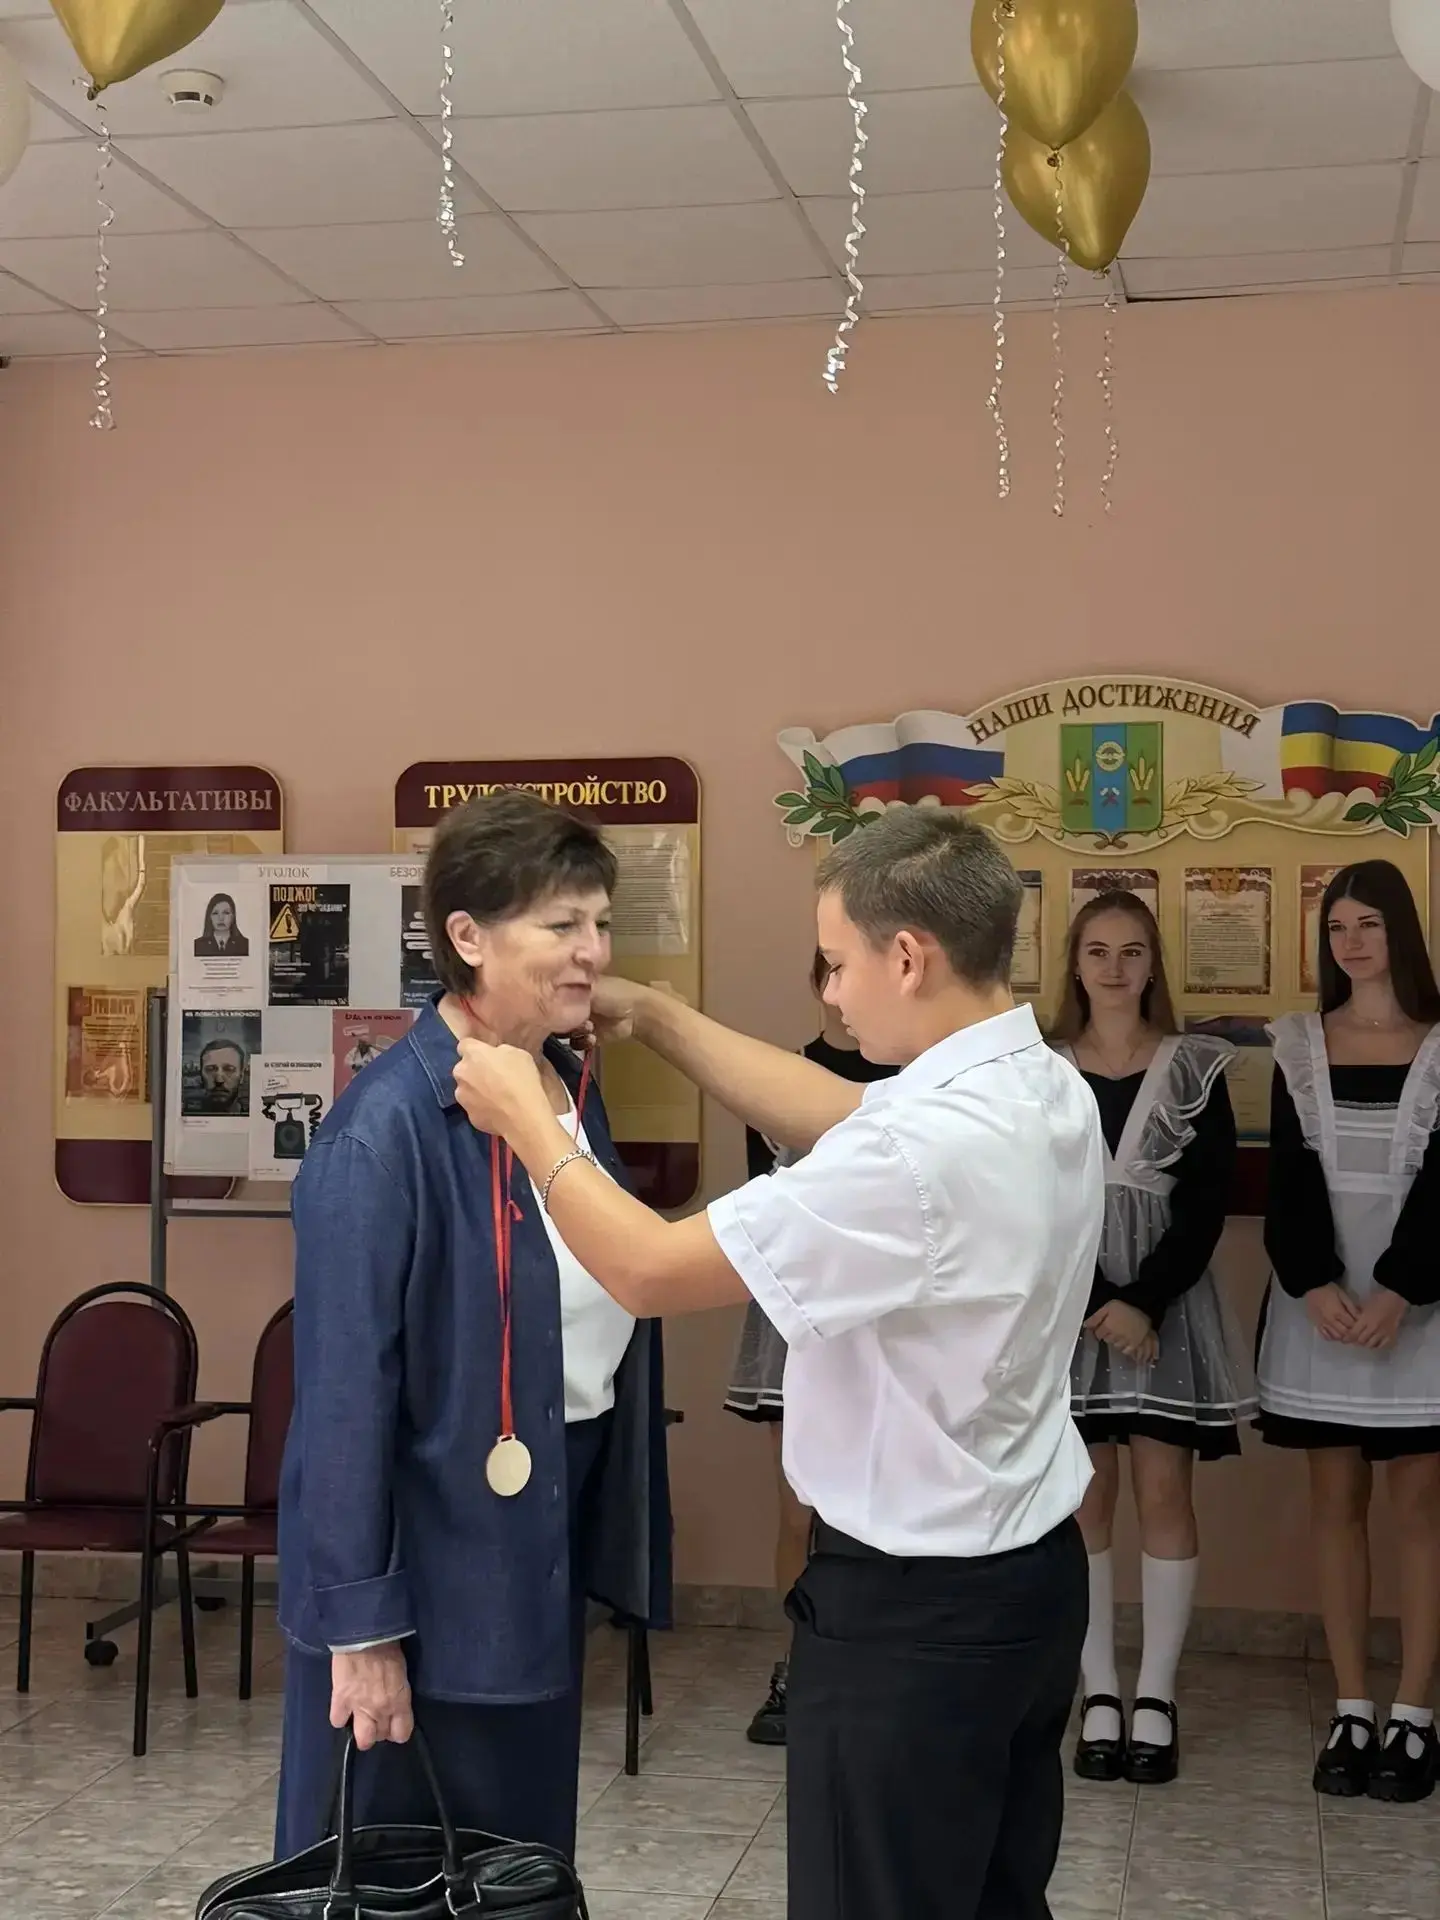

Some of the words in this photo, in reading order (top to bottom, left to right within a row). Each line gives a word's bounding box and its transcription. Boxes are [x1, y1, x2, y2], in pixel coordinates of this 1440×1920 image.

[966, 692, 1054, 745] НАШИ
[1062, 684, 1262, 740] ДОСТИЖЕНИЯ
[64, 789, 273, 812] ФАКУЛЬТАТИВЫ
[424, 775, 667, 809] ТРУДТРОЙСТВО
[258, 866, 310, 878] УГОЛОК
[273, 886, 318, 902] ПОДЖОГ
